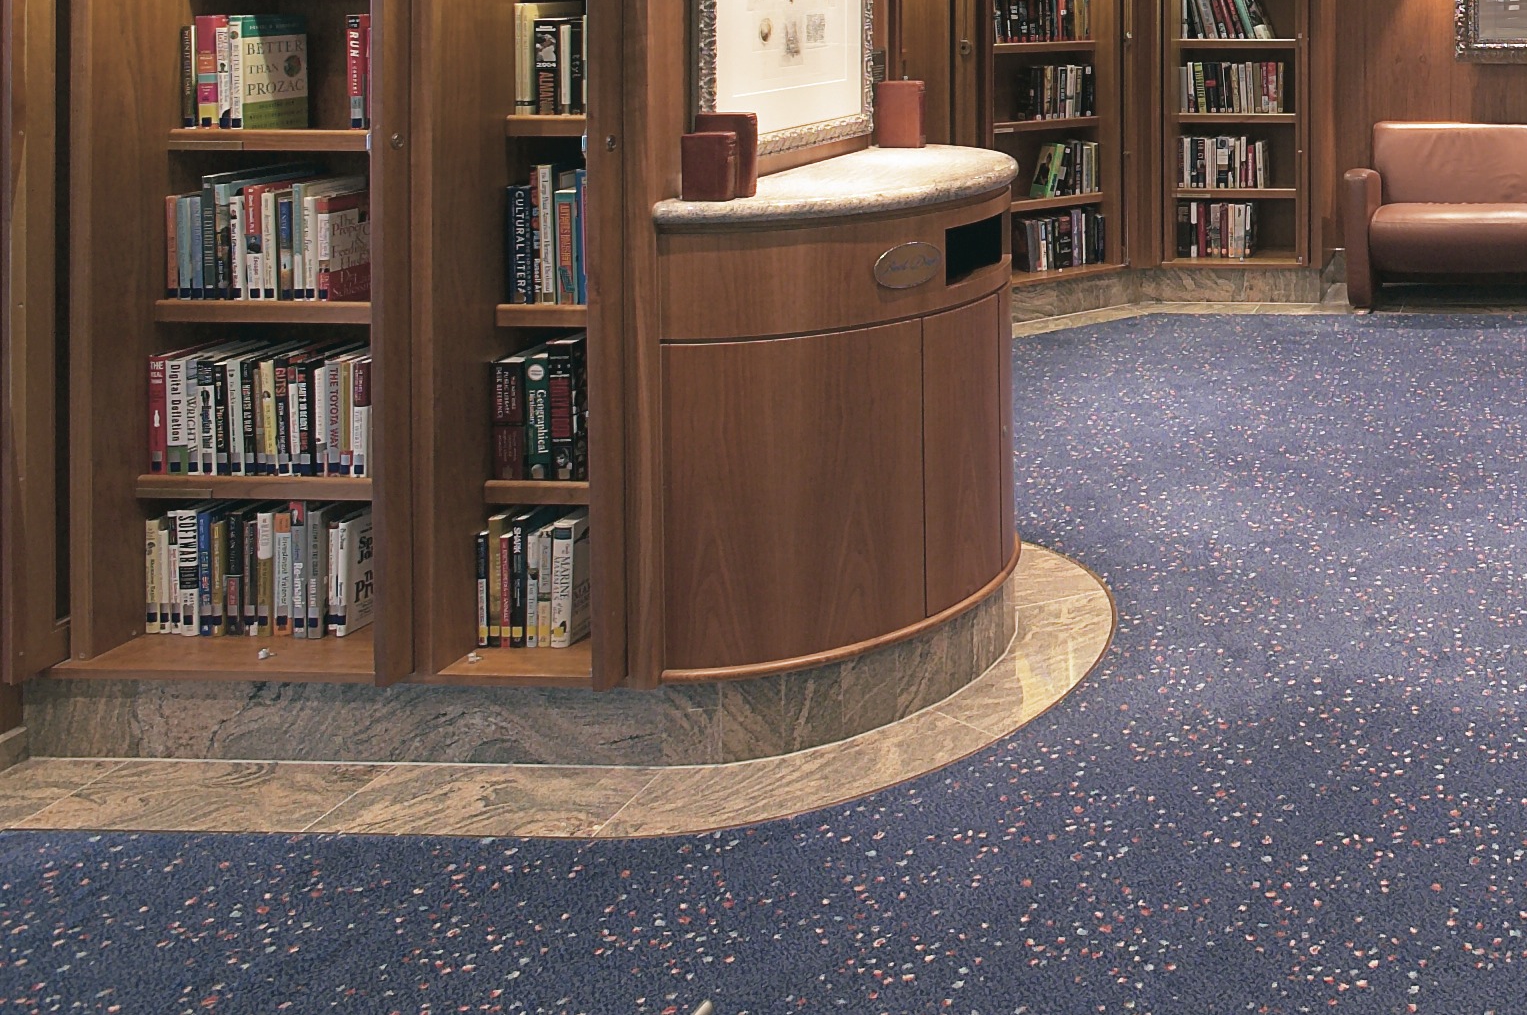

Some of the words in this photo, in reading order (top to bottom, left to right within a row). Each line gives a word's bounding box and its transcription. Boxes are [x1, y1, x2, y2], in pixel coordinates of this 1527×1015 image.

[246, 39, 304, 56] BETTER
[349, 31, 360, 58] RUN
[246, 78, 304, 96] PROZAC
[248, 63, 279, 74] THAN
[539, 72, 555, 115] ALMAN
[515, 190, 526, 251] CULTURAL
[515, 253, 526, 304] LITERA
[150, 360, 164, 370] THE
[169, 364, 181, 395] Digital
[330, 367, 339, 387] THE
[170, 399, 182, 442] Deflation
[186, 396, 197, 444] WRIGHT
[330, 388, 339, 426] TOYOTA
[534, 389, 549, 453] Geographical
[330, 427, 339, 449] WAY
[178, 515, 197, 564] SOFTWAR
[513, 526, 522, 554] SHARK
[553, 556, 561, 601] MAMMALS
[560, 556, 570, 600] MARINE
